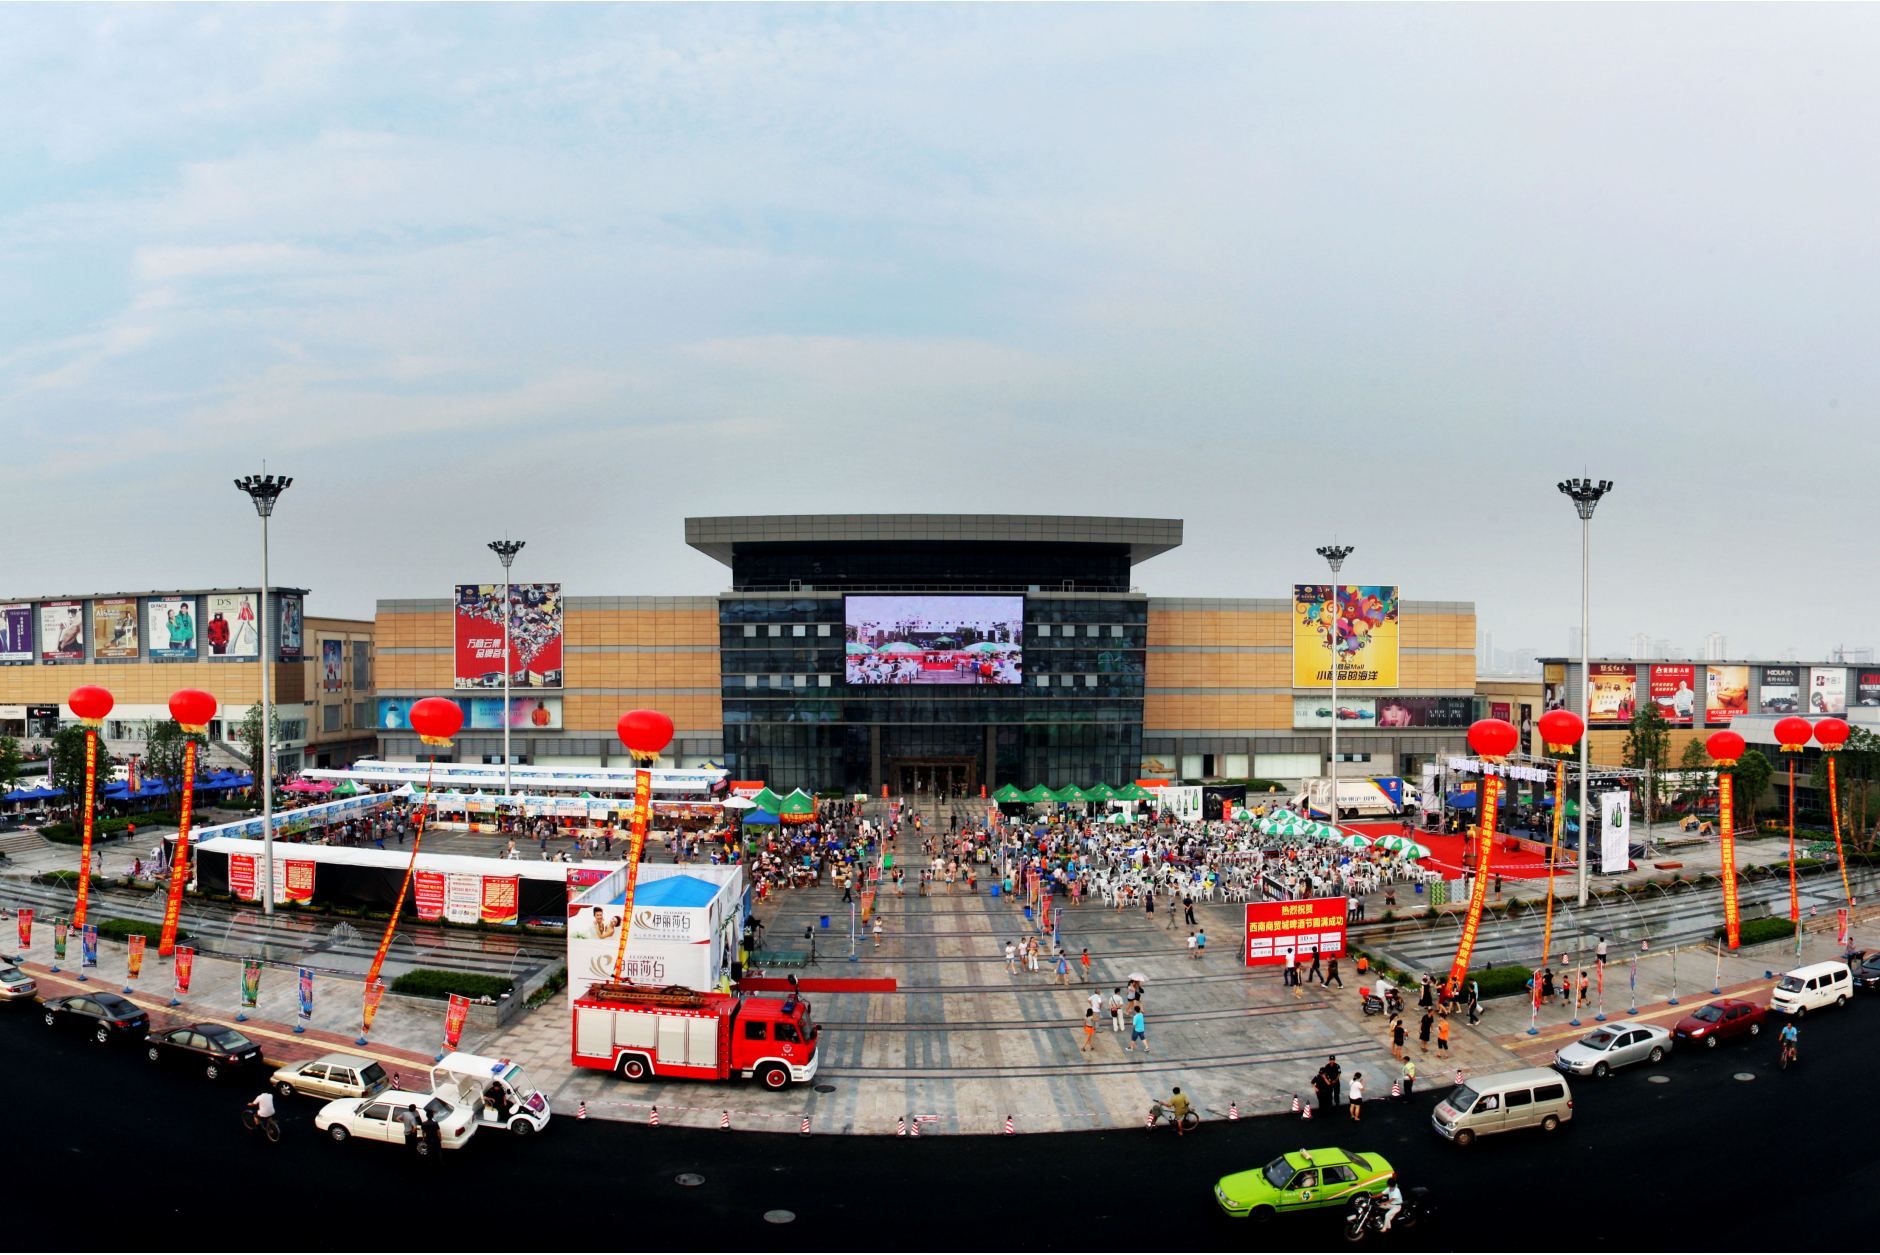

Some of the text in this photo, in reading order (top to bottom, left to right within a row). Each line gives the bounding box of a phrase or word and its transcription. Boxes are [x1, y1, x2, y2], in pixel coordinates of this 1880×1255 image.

[1281, 904, 1313, 916] 热烈祝贺
[652, 914, 691, 929] 伊丽莎白
[1249, 916, 1344, 933] 西南商贸城啤酒节圆满成功
